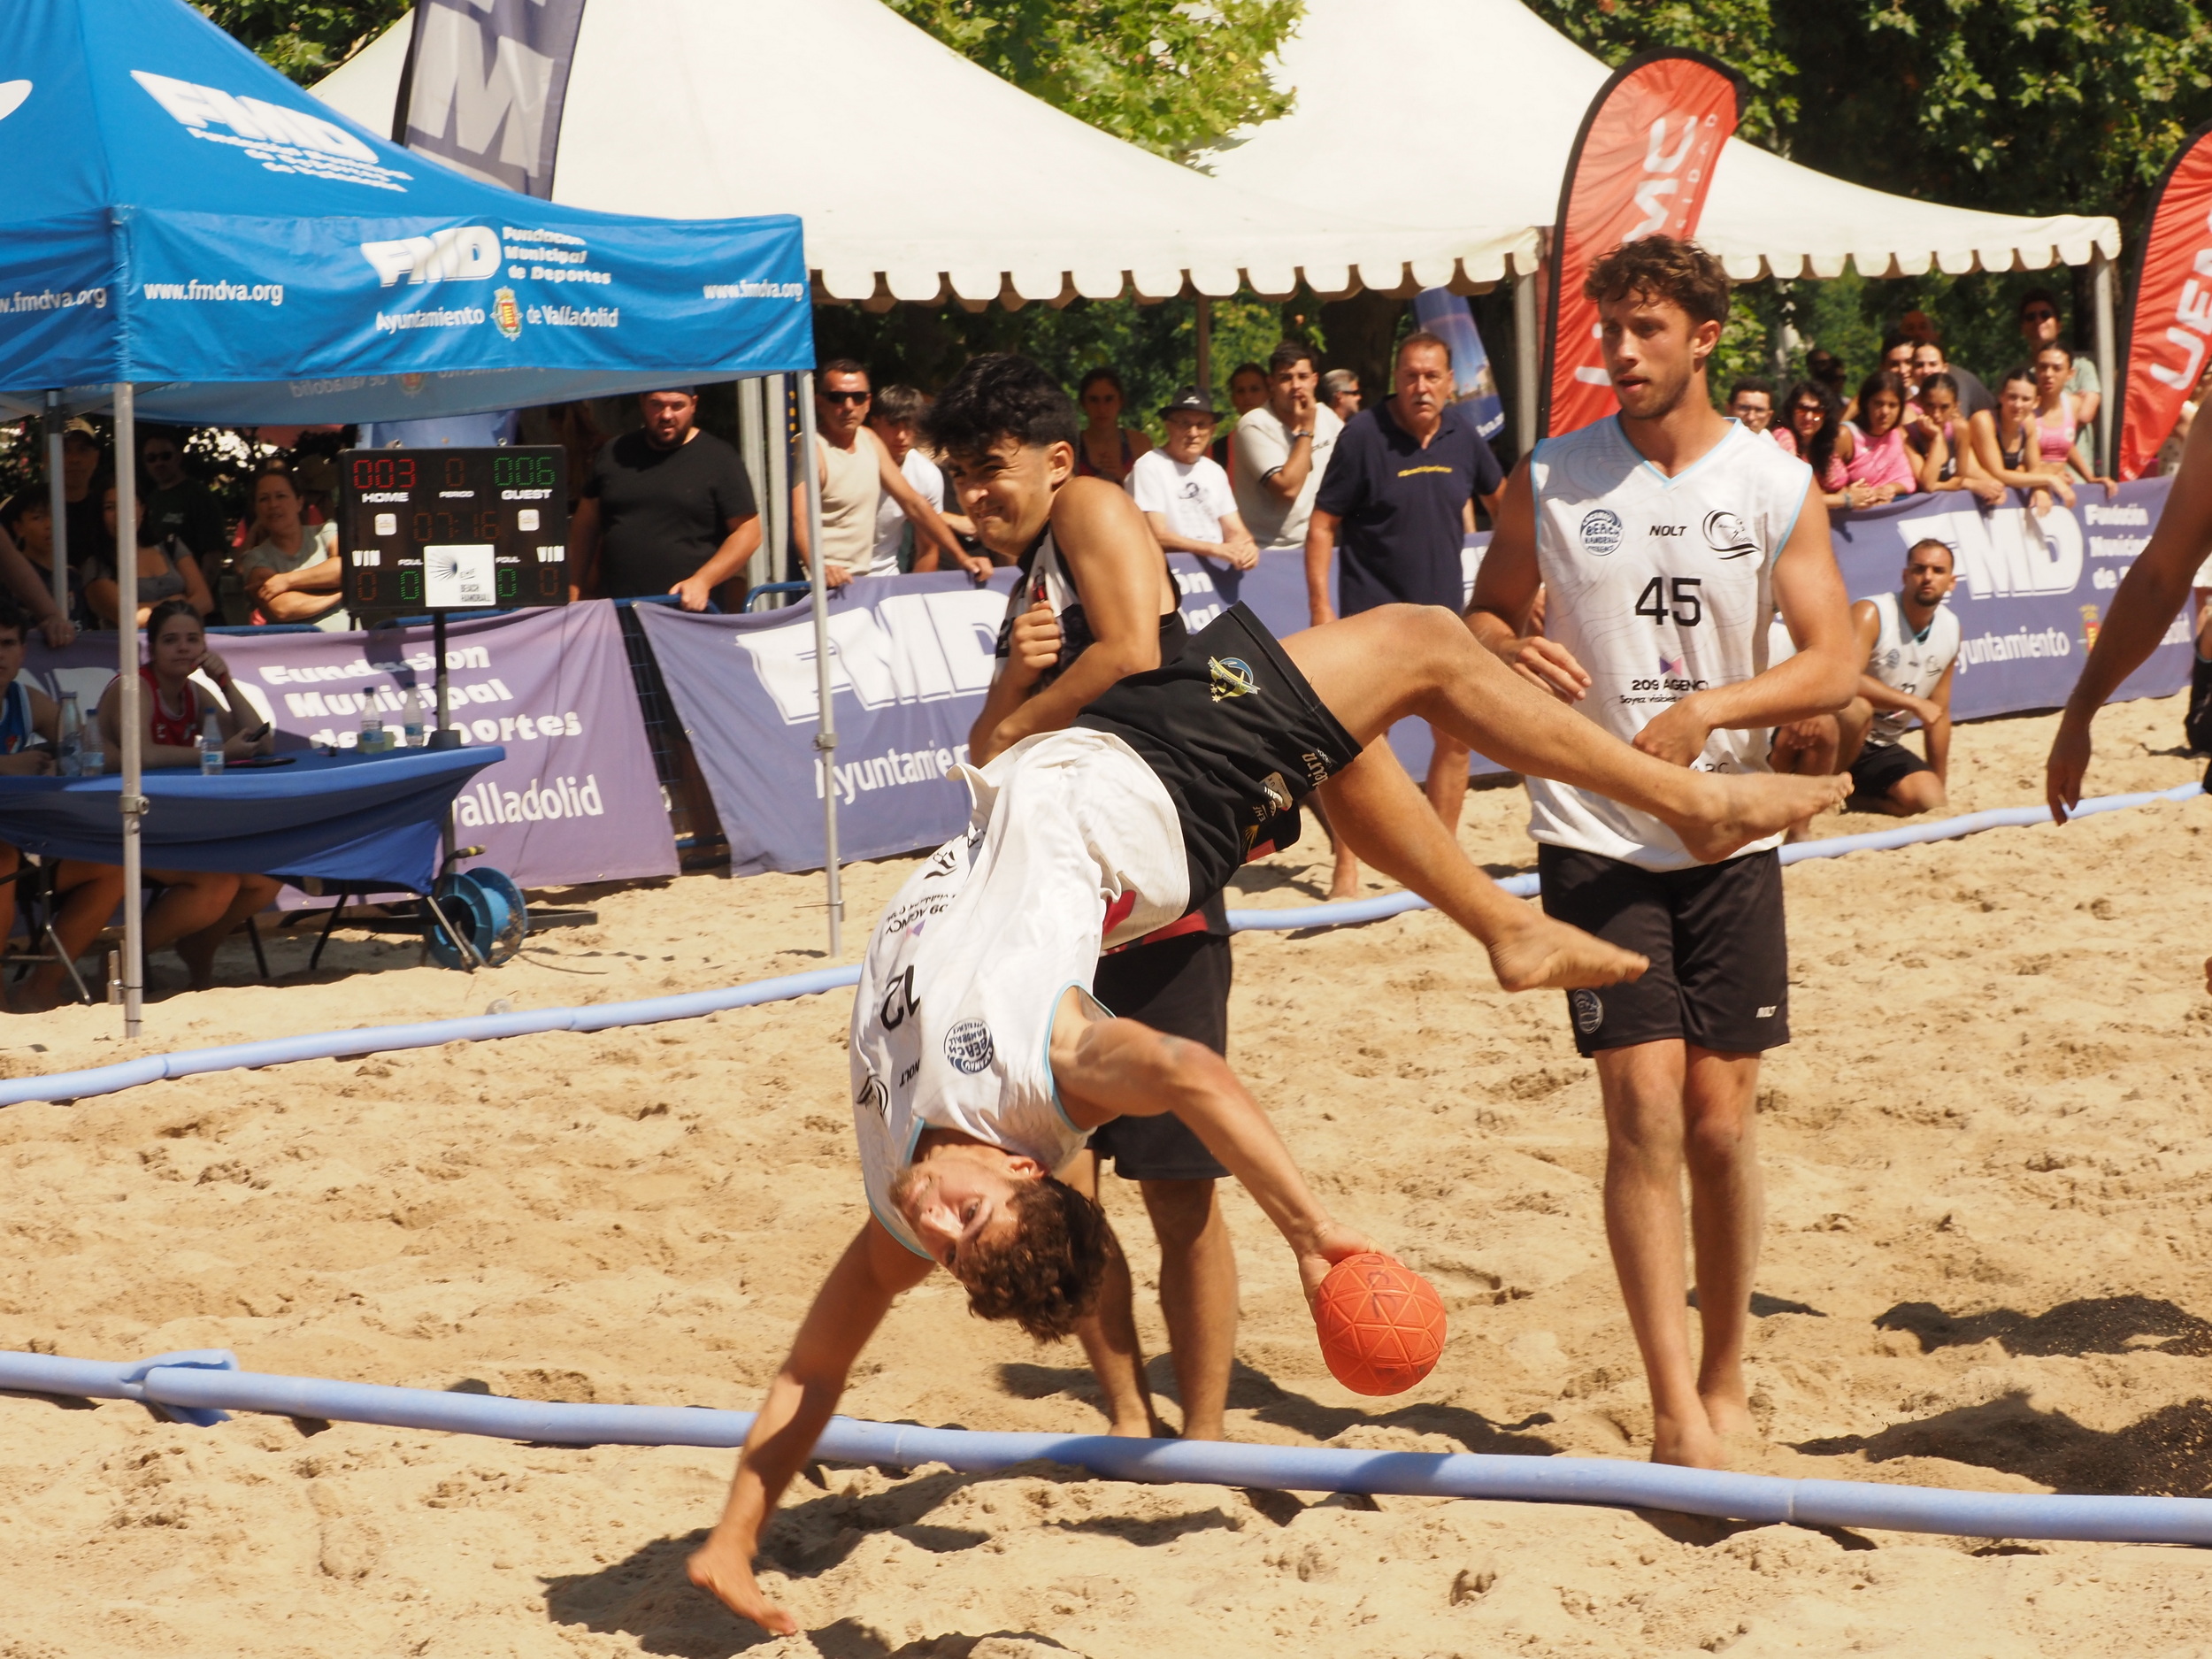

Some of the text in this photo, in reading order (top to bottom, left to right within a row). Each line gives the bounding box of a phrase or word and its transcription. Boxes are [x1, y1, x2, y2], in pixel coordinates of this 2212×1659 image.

[130, 69, 380, 165] FMD
[360, 225, 502, 288] FMD
[504, 246, 588, 265] Municipal
[508, 265, 612, 285] de Deportes
[0, 288, 106, 313] w.fmdva.org
[143, 279, 284, 306] www.fmdva.org
[703, 278, 804, 303] www.fmdva.org
[2149, 208, 2212, 390] UE
[375, 306, 486, 335] Ayuntamiento
[541, 305, 619, 328] Valladolid
[354, 459, 416, 488] 003
[494, 457, 556, 486] 006
[362, 491, 409, 503] HOME
[501, 488, 553, 501] GUEST
[1649, 525, 1687, 536] NOLT
[400, 571, 420, 600] 0
[497, 568, 518, 597] 0
[1635, 576, 1701, 627] 45
[1954, 626, 2070, 674] yuntamiento
[1632, 679, 1709, 691] 209 AGENC
[814, 740, 970, 805] Ayuntamie
